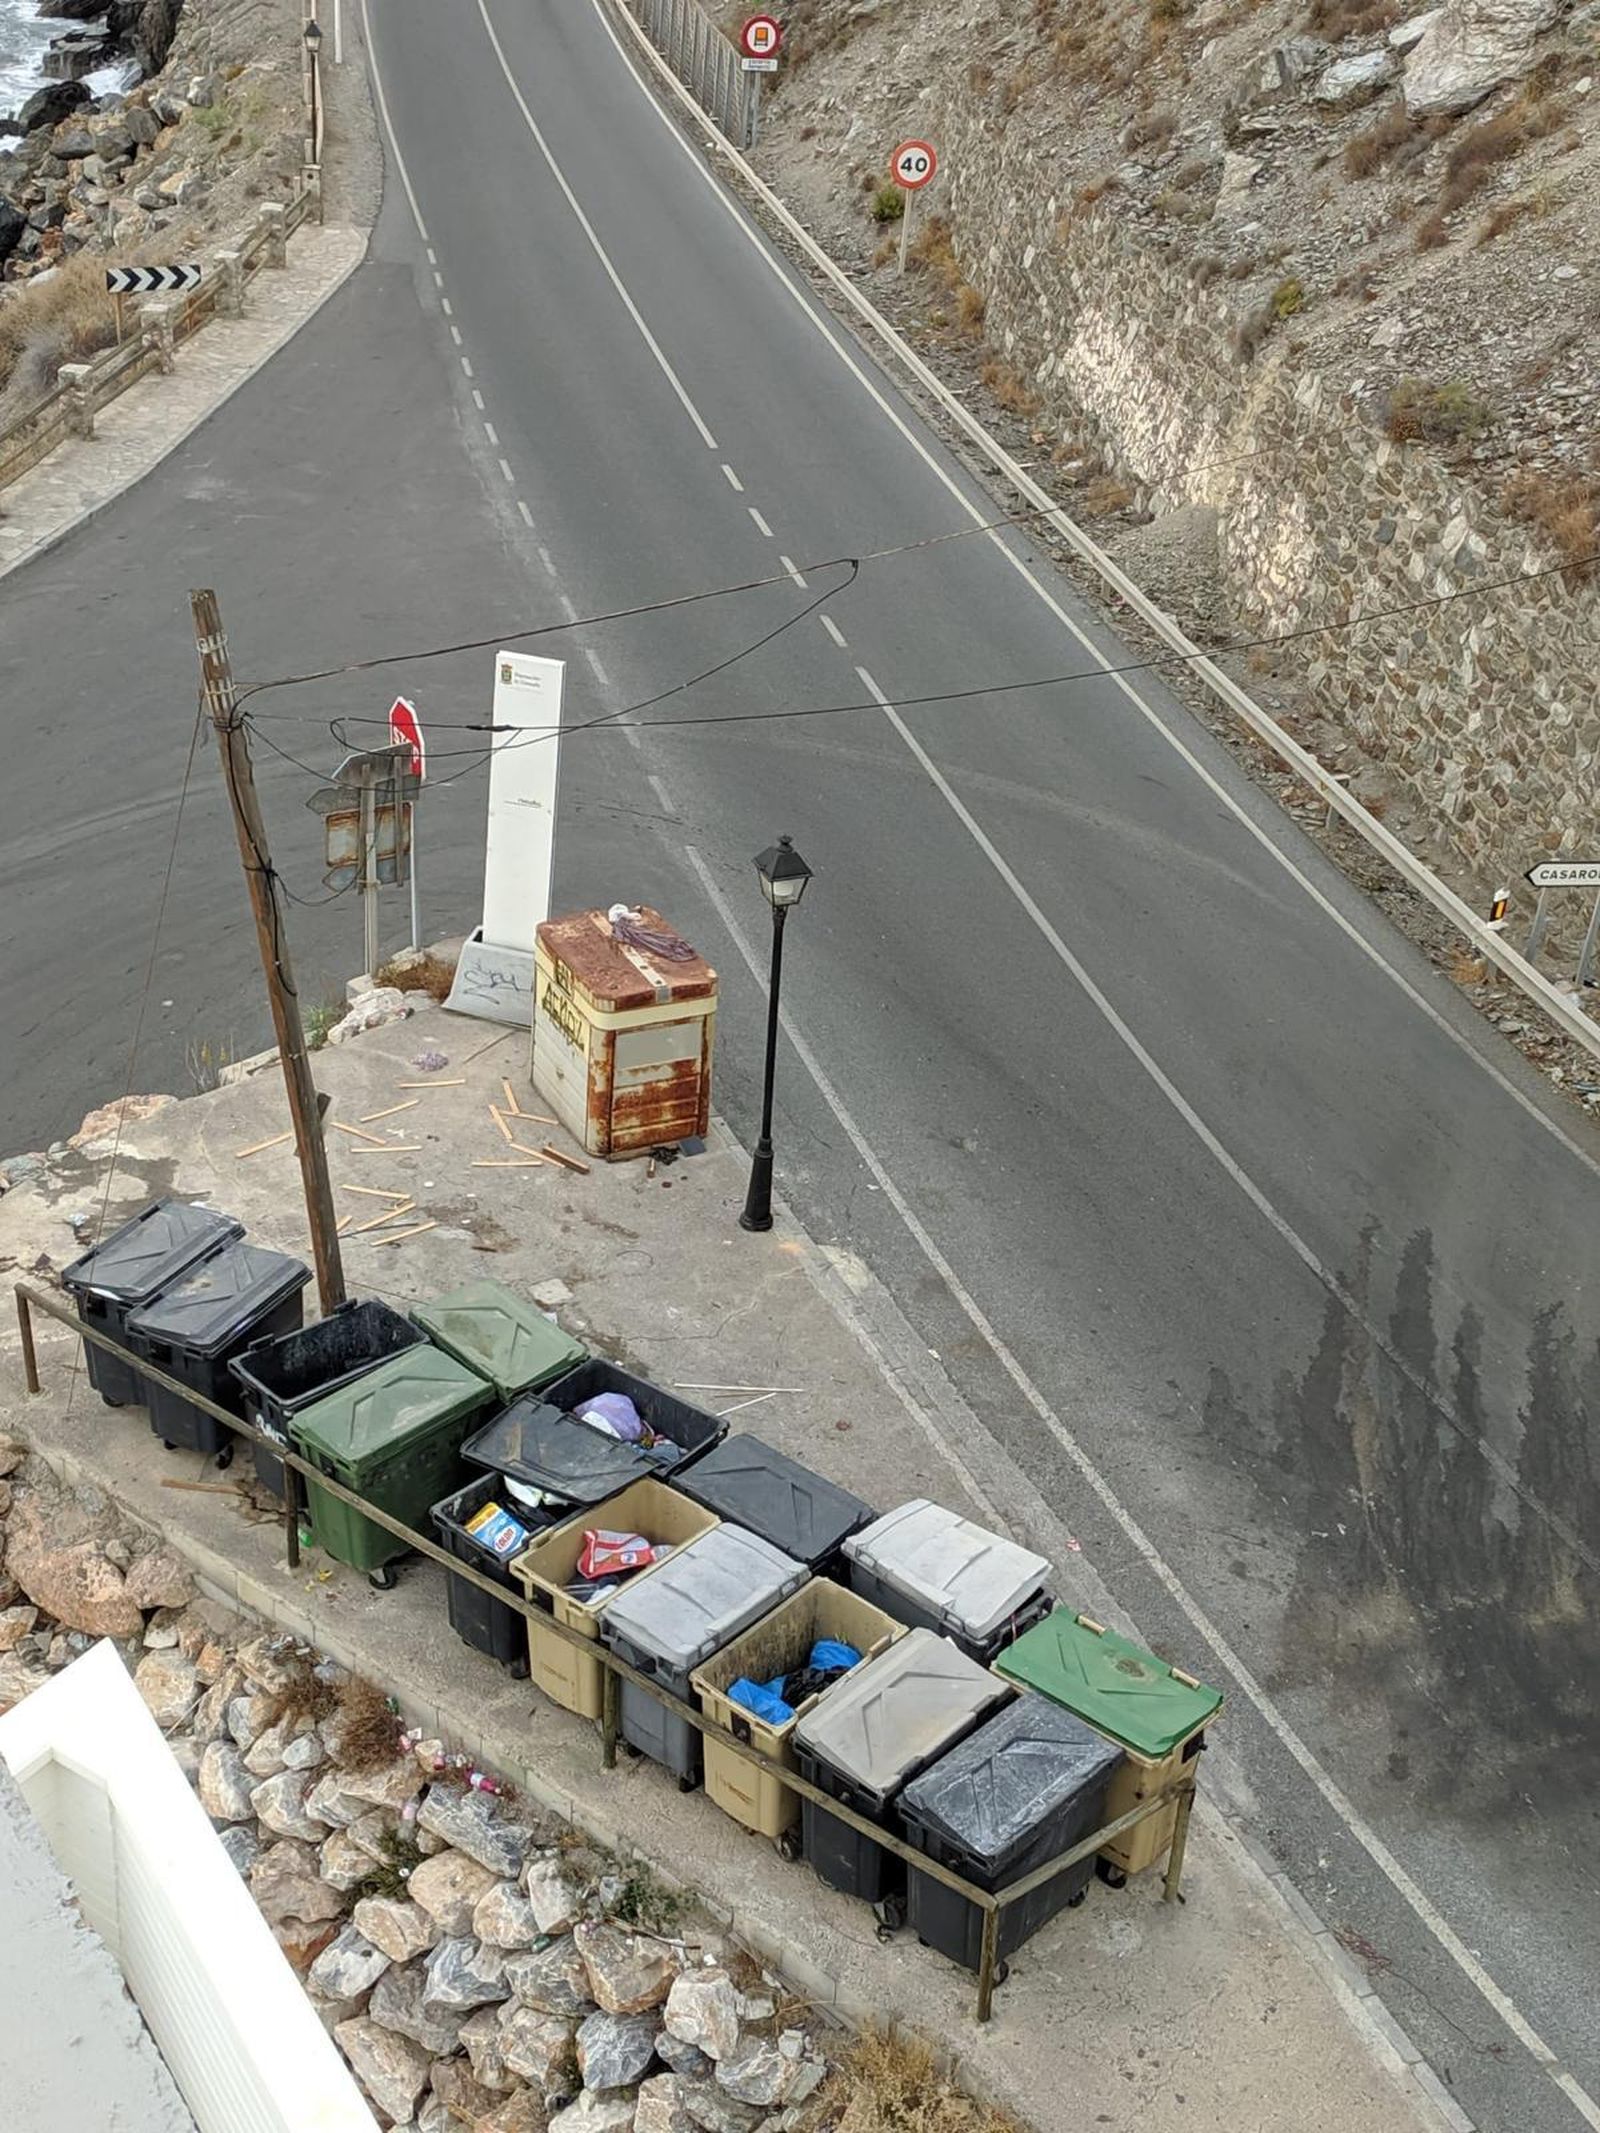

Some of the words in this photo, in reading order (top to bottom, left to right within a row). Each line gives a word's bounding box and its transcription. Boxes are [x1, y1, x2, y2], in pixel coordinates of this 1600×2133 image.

[901, 157, 927, 172] 40
[393, 726, 420, 764] STP
[1540, 870, 1600, 880] CASARO
